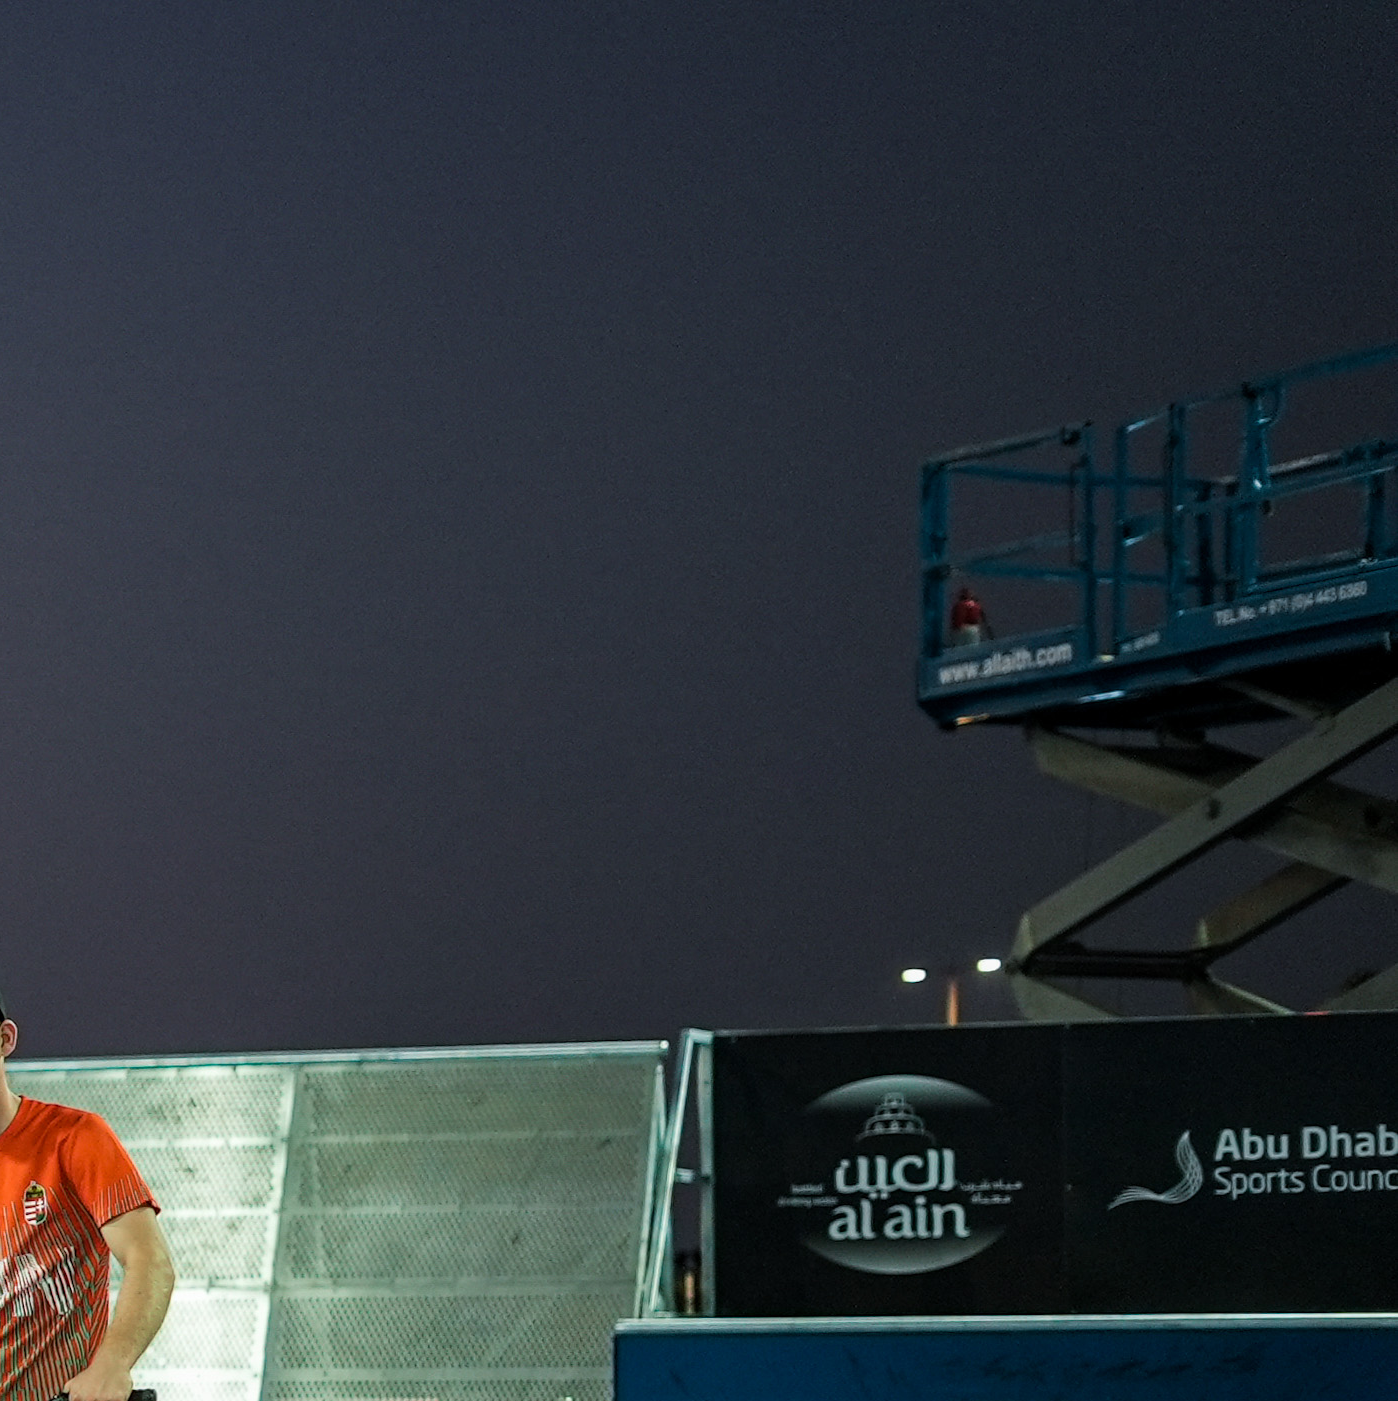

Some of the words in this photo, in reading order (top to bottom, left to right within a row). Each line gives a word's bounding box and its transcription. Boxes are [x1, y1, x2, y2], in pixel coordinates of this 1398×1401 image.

[1214, 1128, 1289, 1162] Abu
[1302, 1123, 1398, 1159] Dhab
[1214, 1166, 1305, 1200] Sports
[1312, 1164, 1398, 1192] Counc
[828, 1198, 877, 1240] al
[883, 1195, 971, 1240] ain
